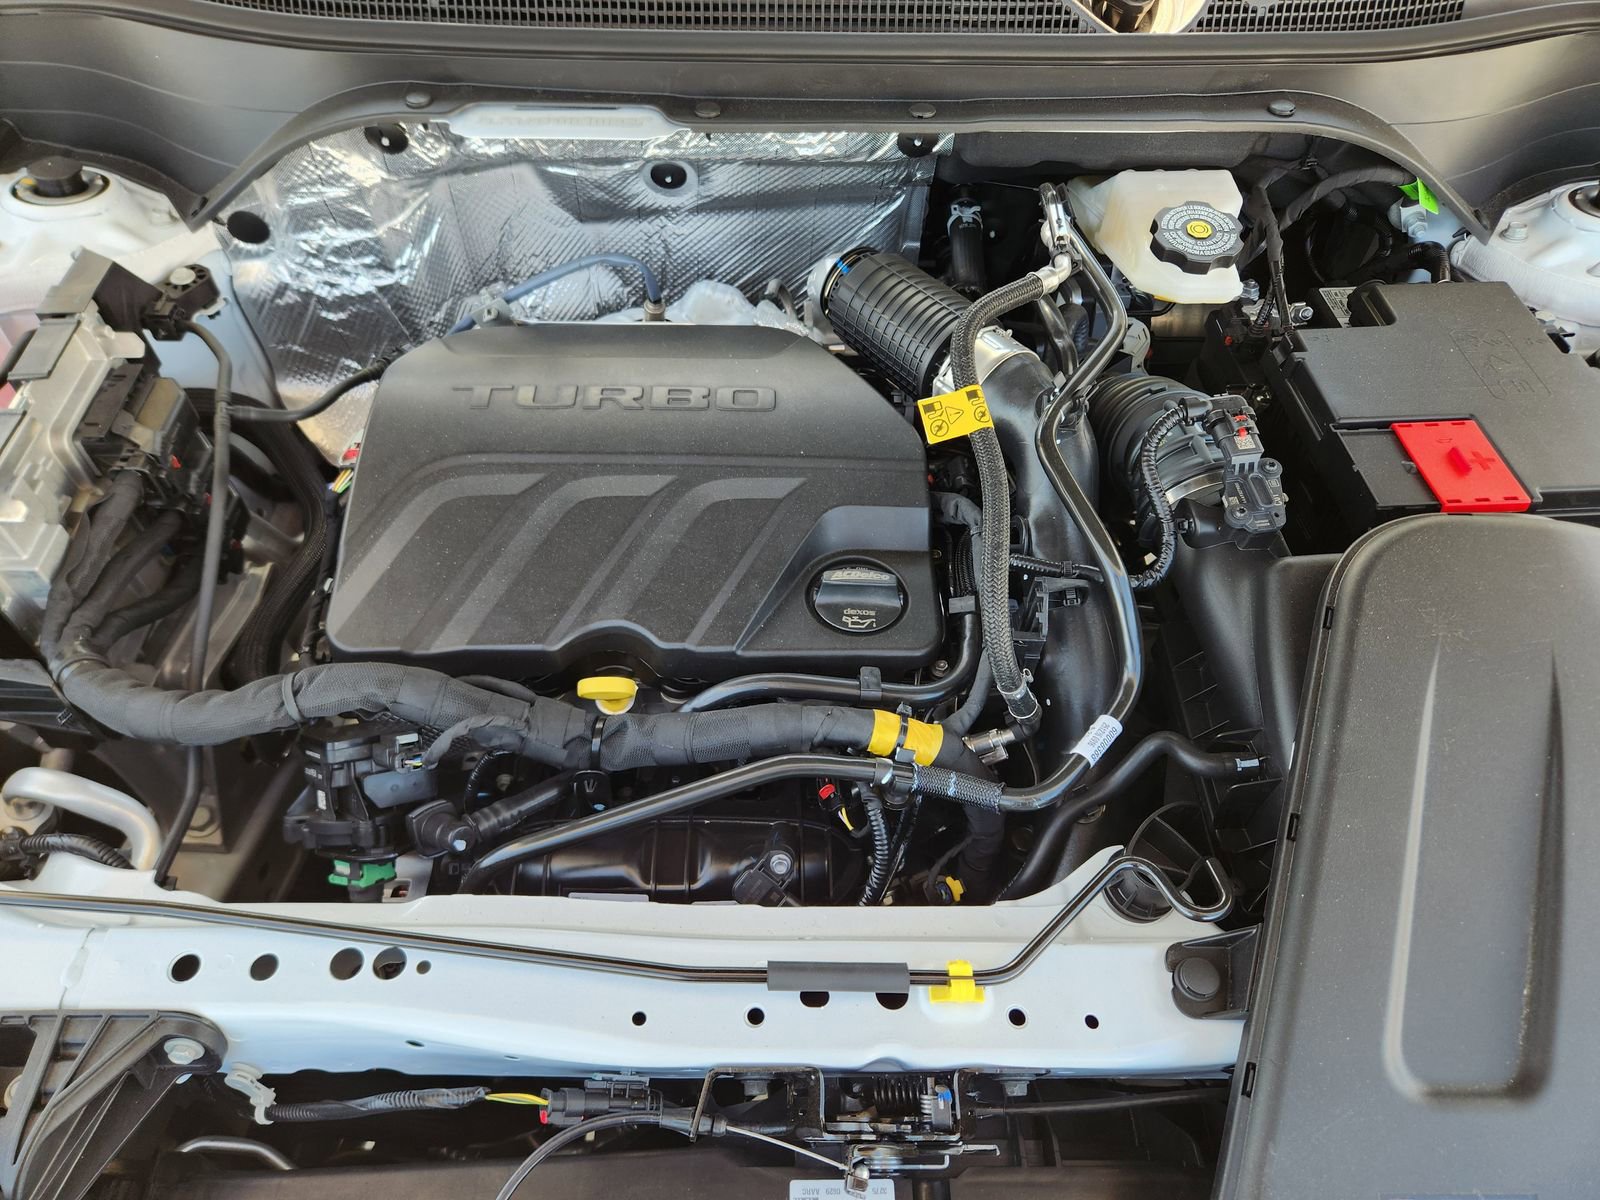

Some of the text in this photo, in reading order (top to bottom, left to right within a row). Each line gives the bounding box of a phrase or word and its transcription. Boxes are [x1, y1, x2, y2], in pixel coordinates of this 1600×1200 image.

[451, 383, 778, 412] TURBO
[830, 571, 891, 581] ACDelco
[843, 608, 877, 616] dexos
